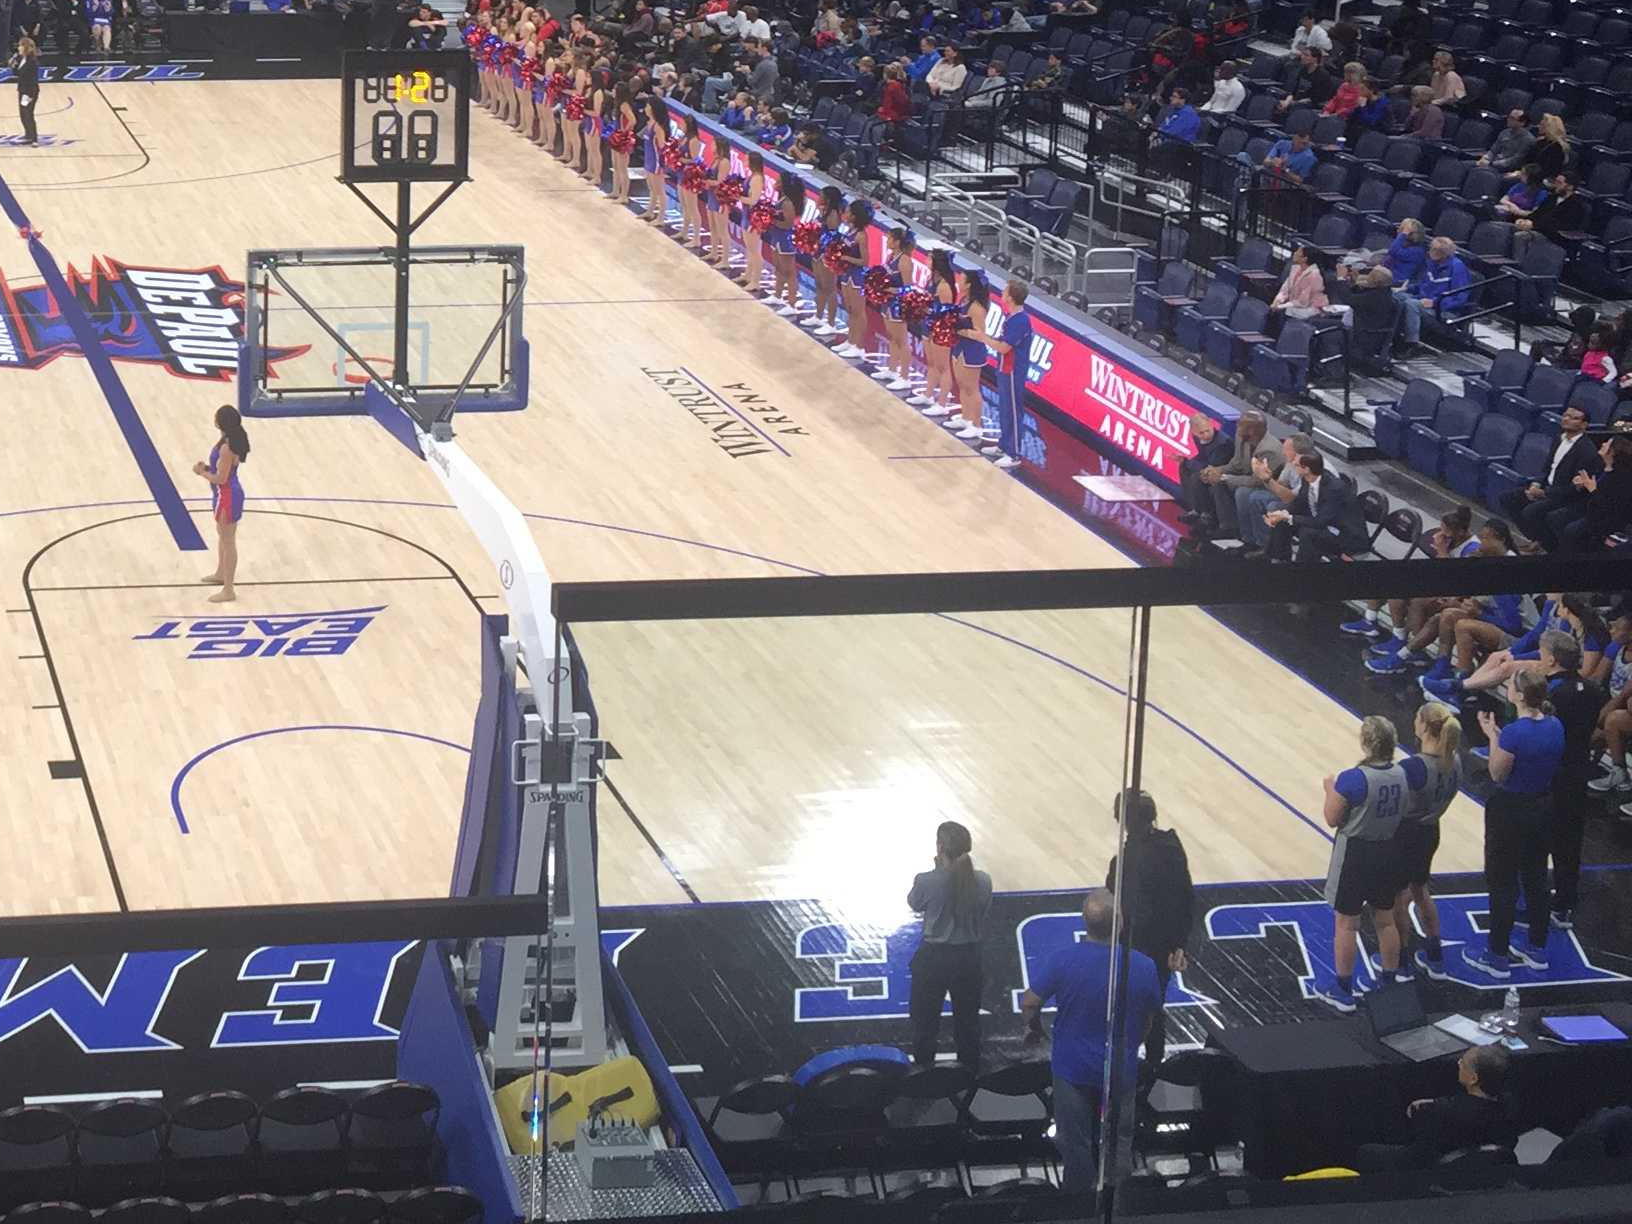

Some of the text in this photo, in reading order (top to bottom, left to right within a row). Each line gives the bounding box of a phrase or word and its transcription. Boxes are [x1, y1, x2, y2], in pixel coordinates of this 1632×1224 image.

[640, 366, 773, 460] WINTRUST
[721, 382, 811, 436] ARENA
[1090, 353, 1192, 447] WINTRUST
[1099, 413, 1164, 470] ARENA
[131, 616, 377, 641] EAST
[186, 634, 360, 660] BIG
[529, 791, 585, 804] SPADING
